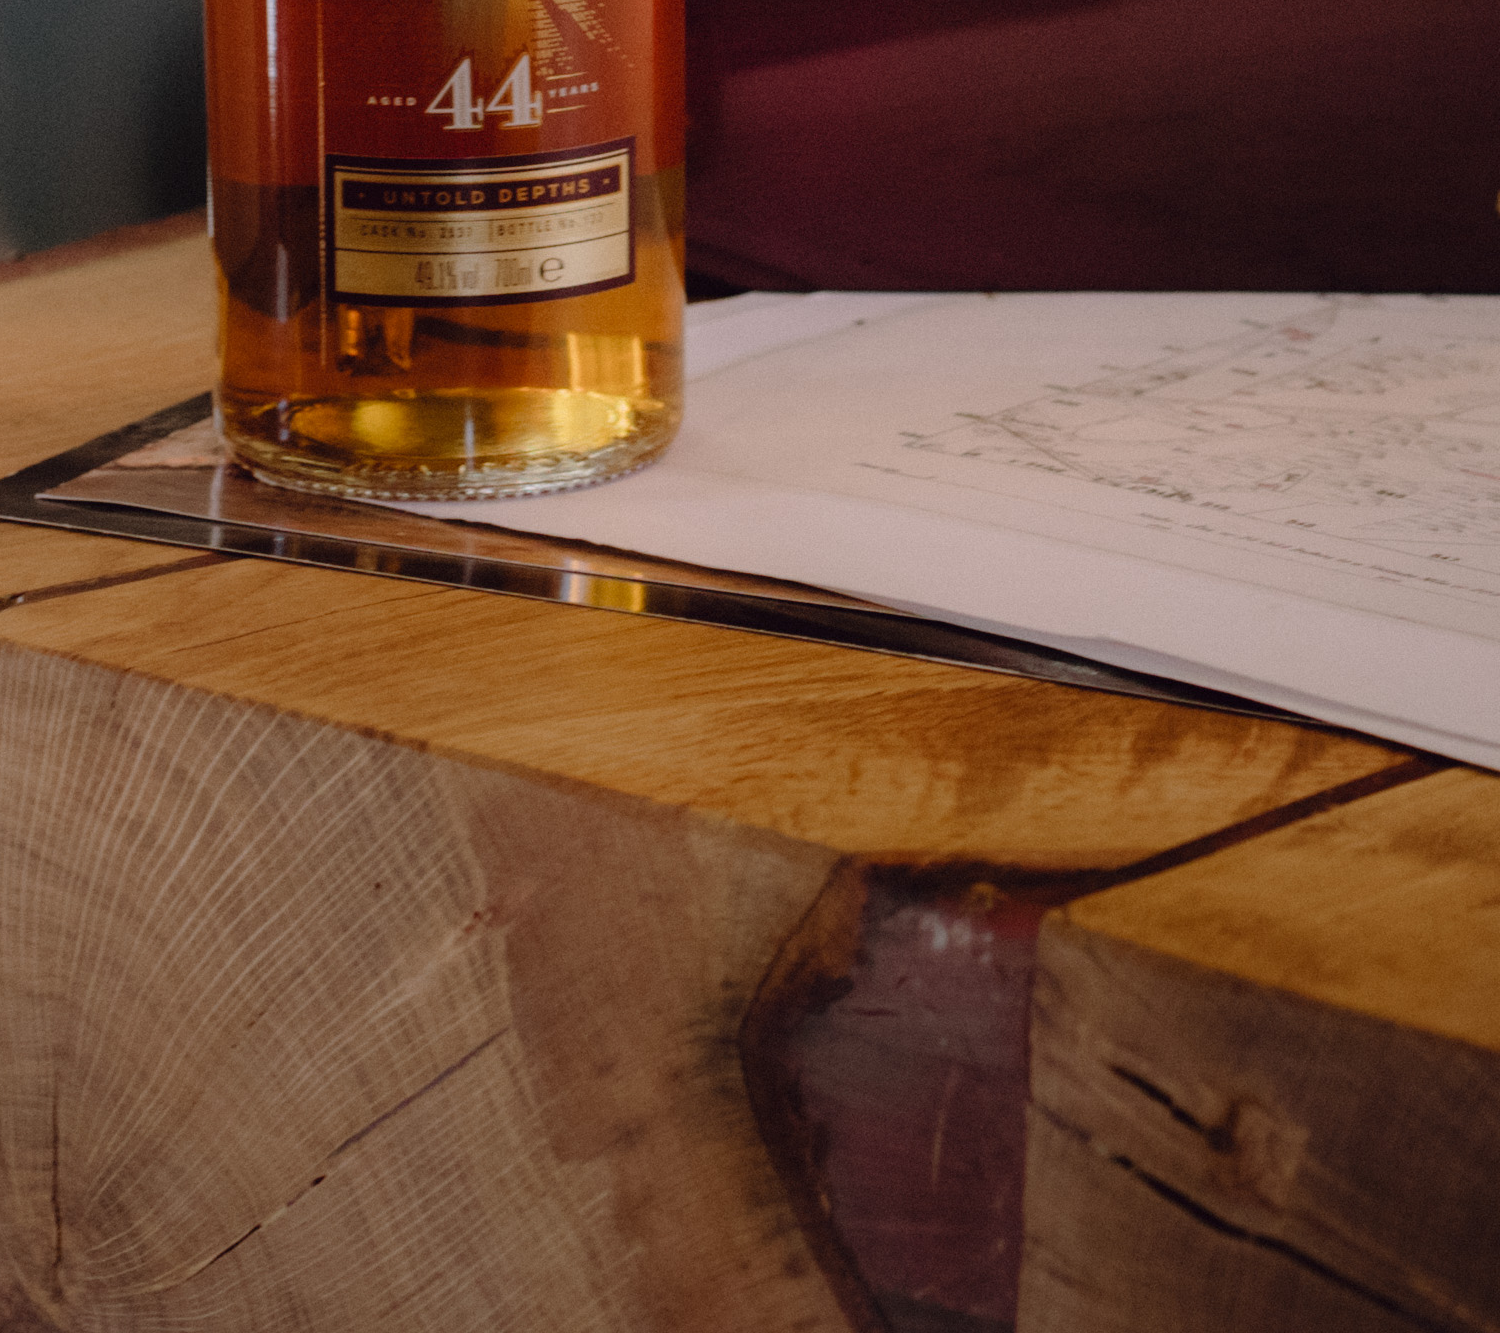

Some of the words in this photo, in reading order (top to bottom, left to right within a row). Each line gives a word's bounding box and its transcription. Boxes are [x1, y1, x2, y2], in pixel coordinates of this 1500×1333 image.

[366, 95, 418, 107] AGED
[424, 51, 543, 131] 44
[548, 82, 600, 99] YEARS
[383, 189, 487, 207] UNTOLD
[498, 177, 592, 205] DEPTHS
